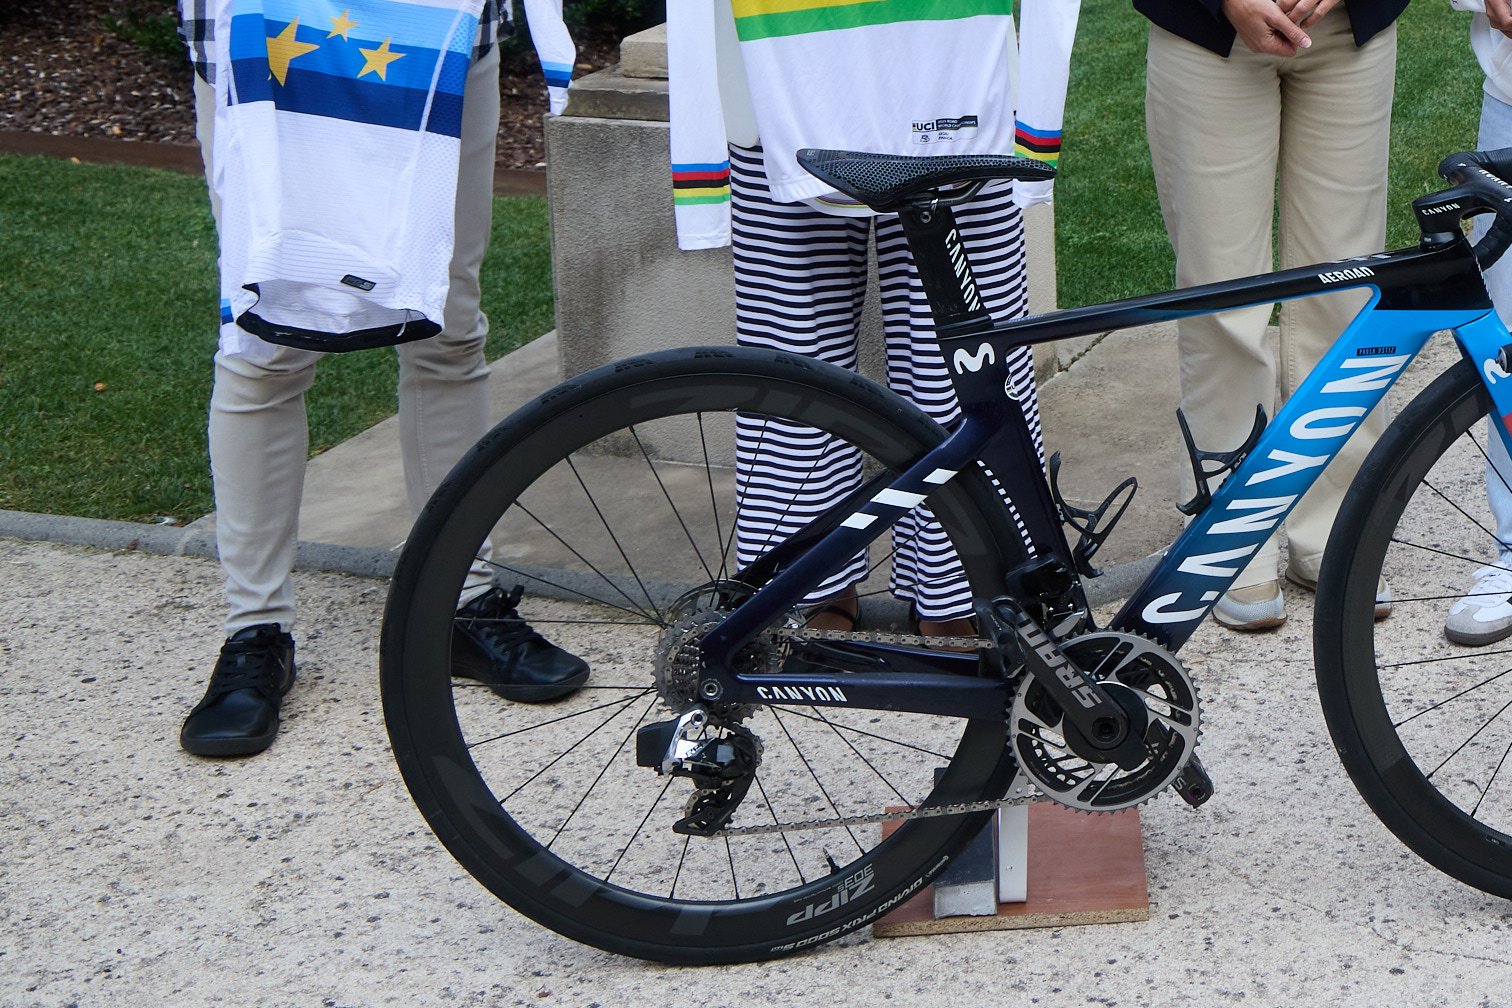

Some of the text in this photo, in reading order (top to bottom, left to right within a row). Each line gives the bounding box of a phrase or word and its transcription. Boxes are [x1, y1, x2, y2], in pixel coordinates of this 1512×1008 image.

[916, 122, 935, 131] UCI
[1421, 203, 1461, 216] CANYON
[945, 229, 981, 312] CANYON
[1318, 267, 1375, 284] AEROAD
[1142, 354, 1412, 624] CANYON
[1016, 612, 1102, 709] SRAM
[757, 686, 848, 702] CANYON
[786, 873, 875, 926] ZIPP
[878, 877, 923, 913] GRAND
[841, 908, 877, 932] PRIX
[795, 926, 841, 948] 5000
